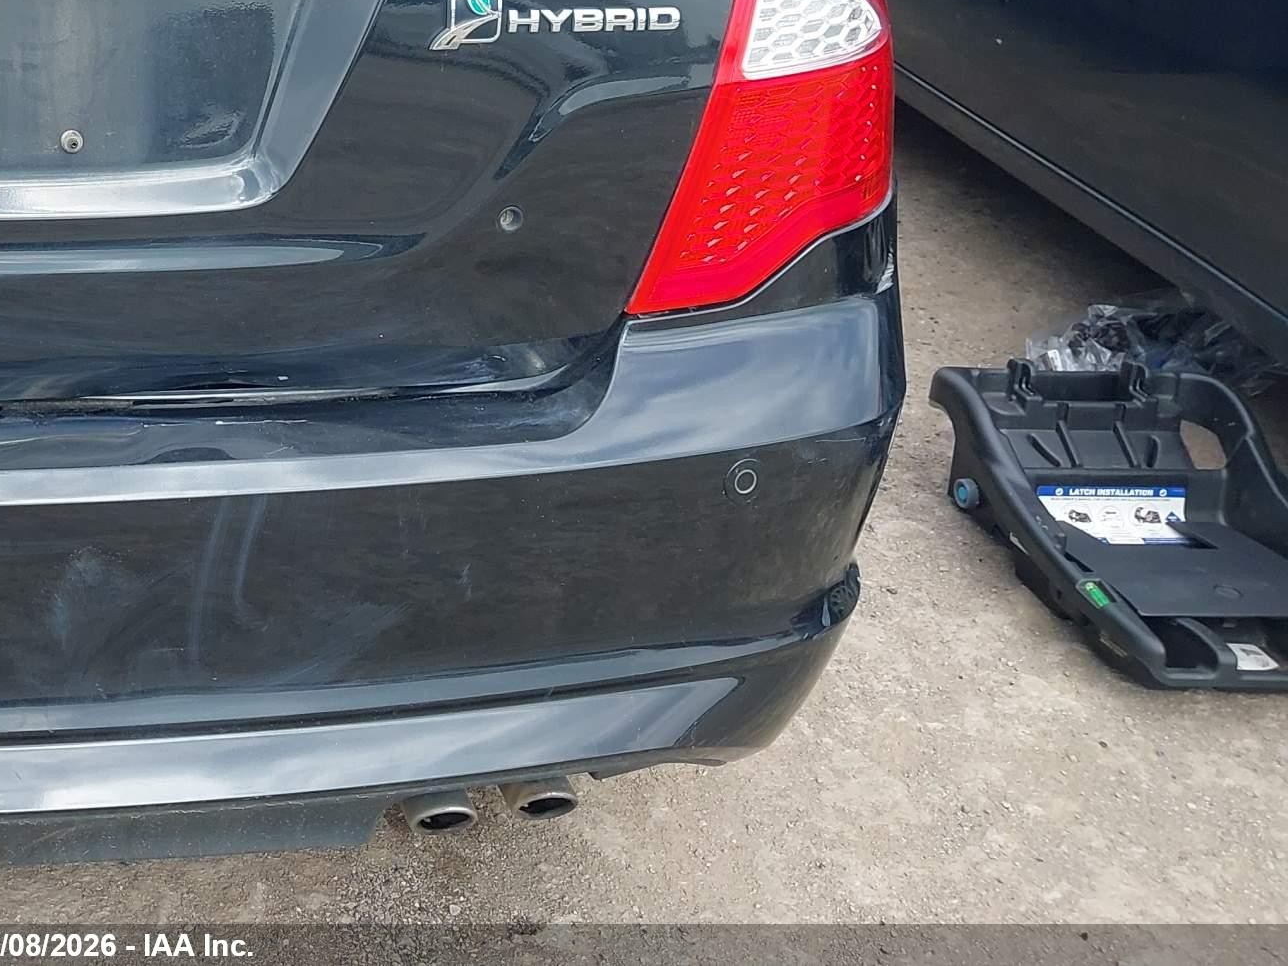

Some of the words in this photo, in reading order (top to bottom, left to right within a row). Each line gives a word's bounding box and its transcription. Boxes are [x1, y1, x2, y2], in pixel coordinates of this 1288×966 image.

[508, 7, 681, 33] HYBRID
[1069, 488, 1096, 496] LATCH
[1097, 488, 1154, 497] INSTALLATION
